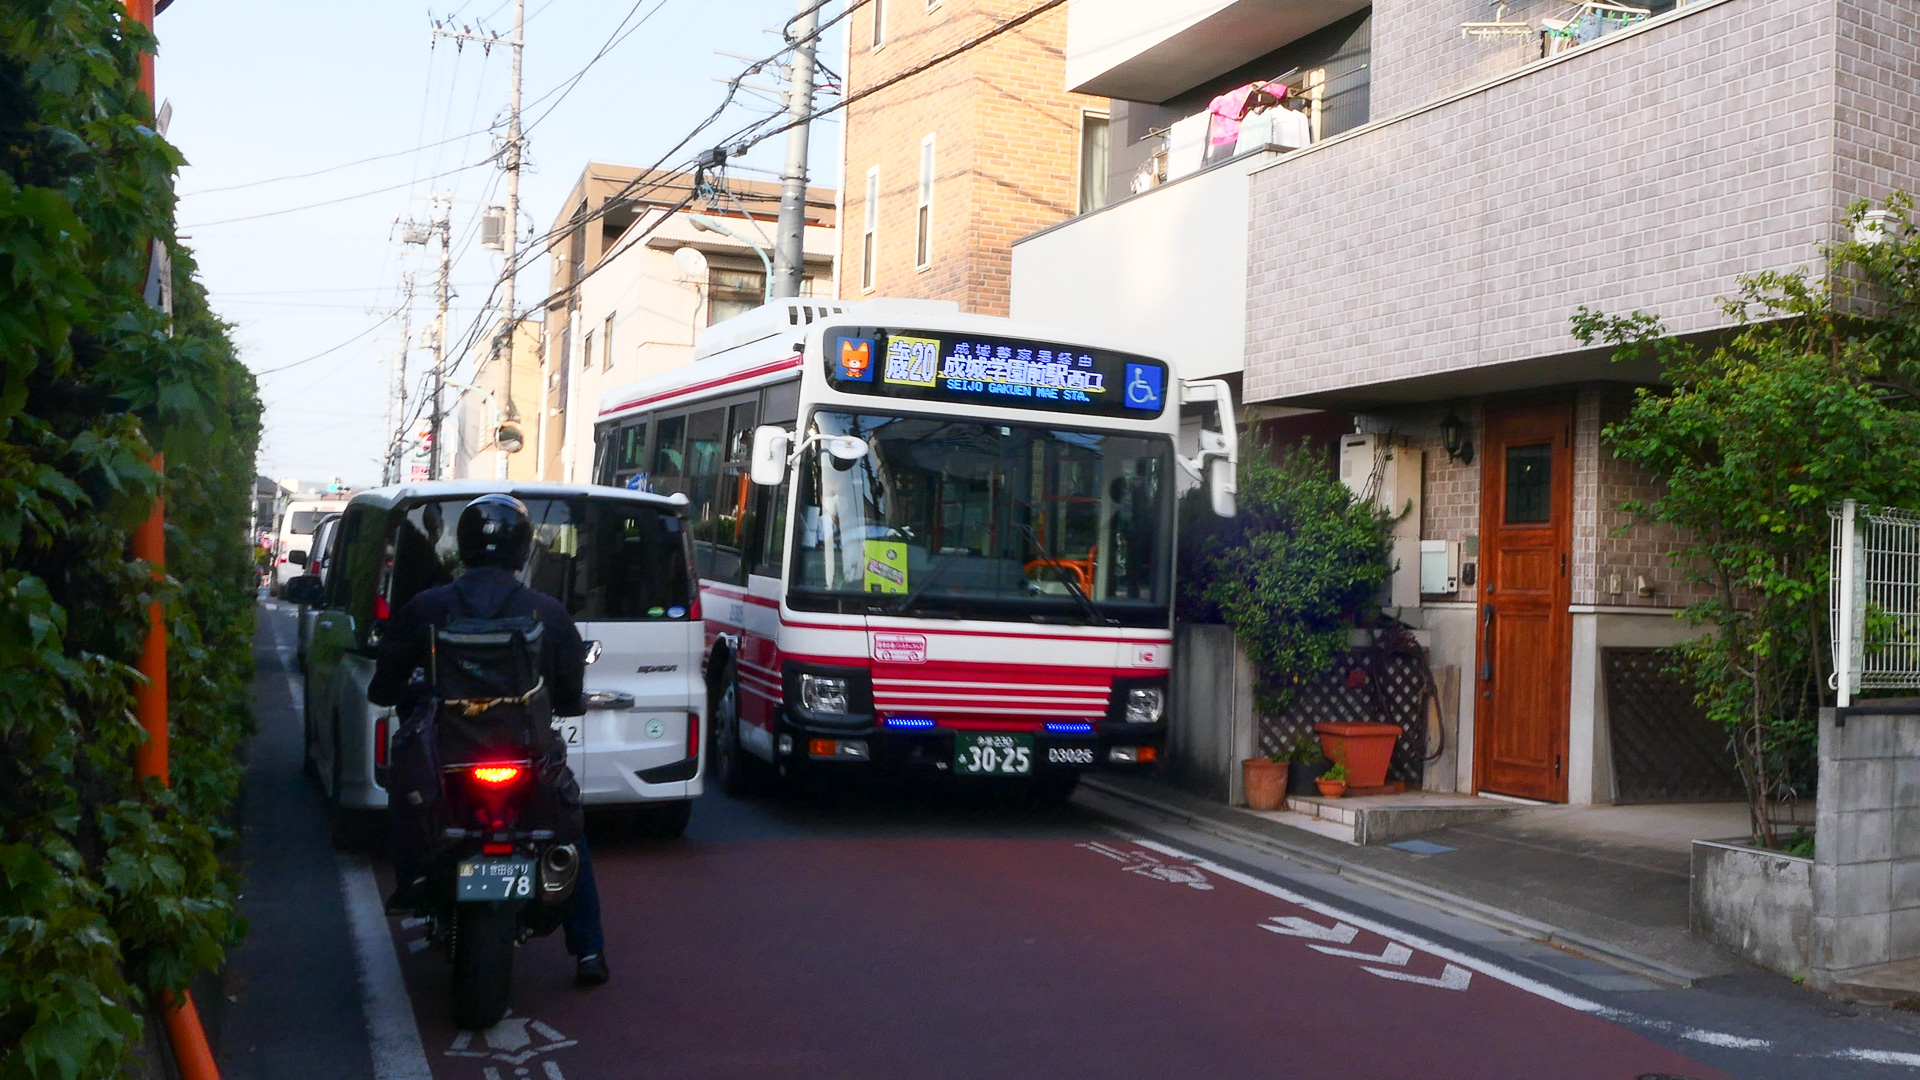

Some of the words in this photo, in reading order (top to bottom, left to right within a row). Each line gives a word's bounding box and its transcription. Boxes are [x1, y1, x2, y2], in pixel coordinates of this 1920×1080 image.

[887, 340, 937, 382] 歳20
[943, 353, 1104, 390] 成城学園前駅西口
[946, 378, 983, 392] SEIJO
[987, 382, 1032, 397] GAKUEN
[1035, 387, 1058, 400] MAE
